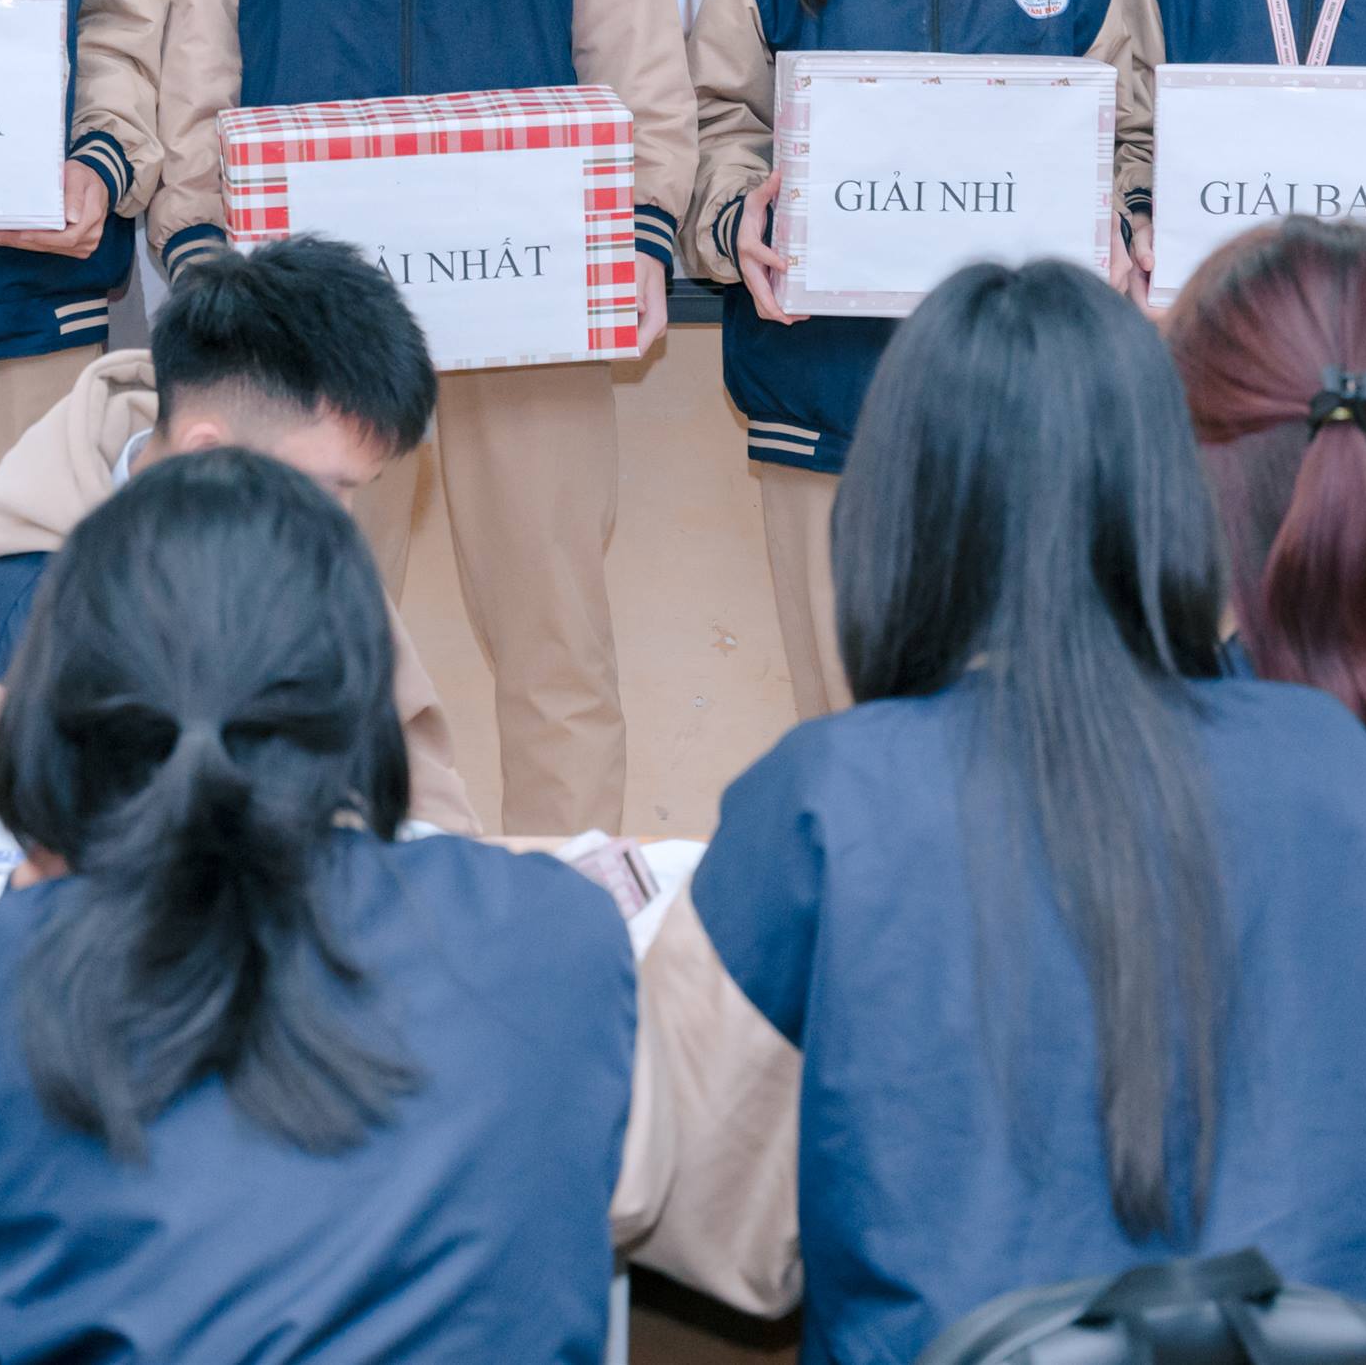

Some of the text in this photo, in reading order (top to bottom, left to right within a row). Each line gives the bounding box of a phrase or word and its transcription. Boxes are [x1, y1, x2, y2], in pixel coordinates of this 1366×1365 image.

[834, 172, 1017, 214] GIẢI NHÌ
[1200, 172, 1299, 216] GIẢI
[424, 237, 551, 283] NHẤT
